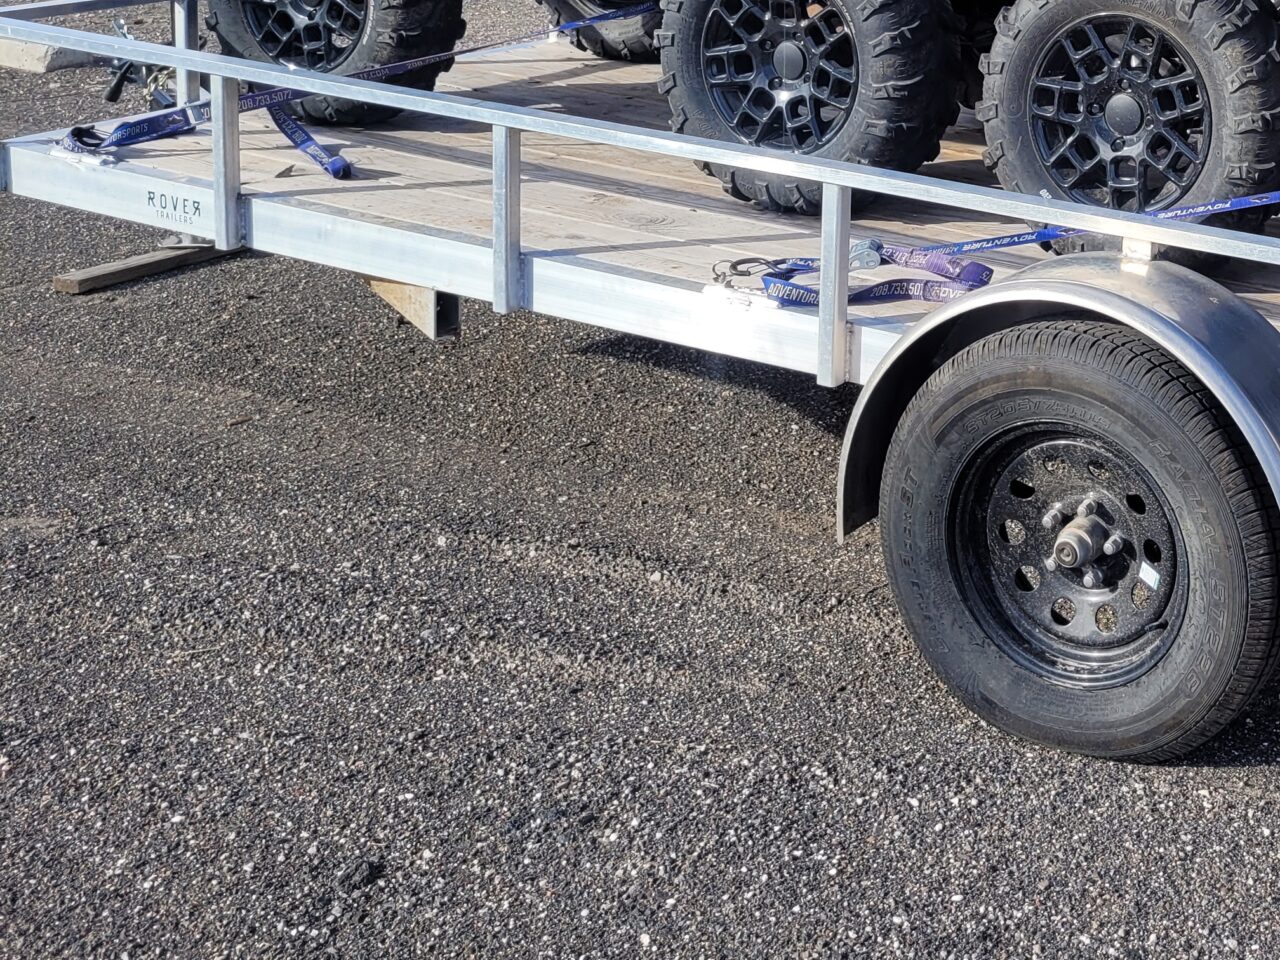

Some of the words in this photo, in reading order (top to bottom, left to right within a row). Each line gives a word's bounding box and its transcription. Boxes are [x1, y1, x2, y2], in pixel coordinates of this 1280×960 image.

[147, 190, 201, 217] ROVER
[156, 209, 193, 225] TRAILERS
[961, 232, 1039, 252] ADVENTURE
